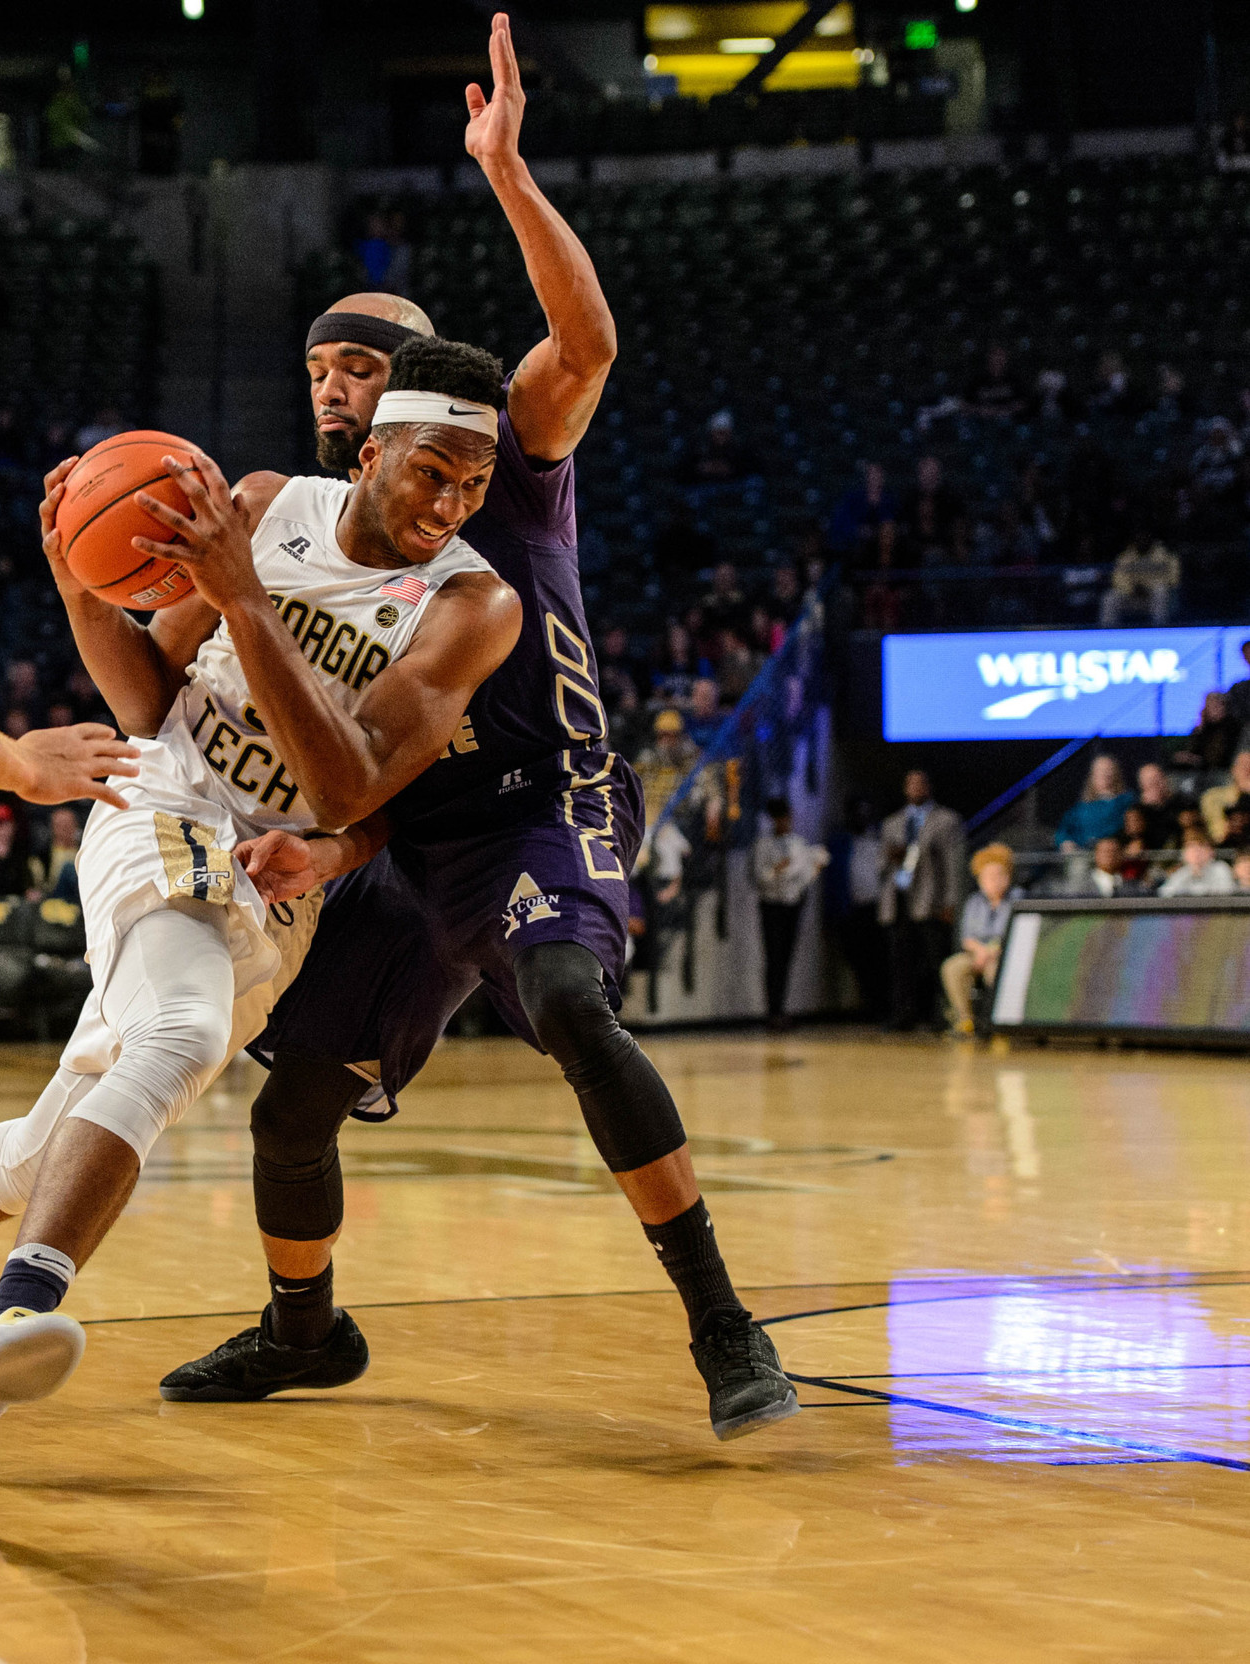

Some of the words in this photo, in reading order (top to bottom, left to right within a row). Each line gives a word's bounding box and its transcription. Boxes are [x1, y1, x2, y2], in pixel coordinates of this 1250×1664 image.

[267, 592, 392, 693] ORGIA
[192, 696, 300, 814] TECH
[175, 865, 230, 888] GT
